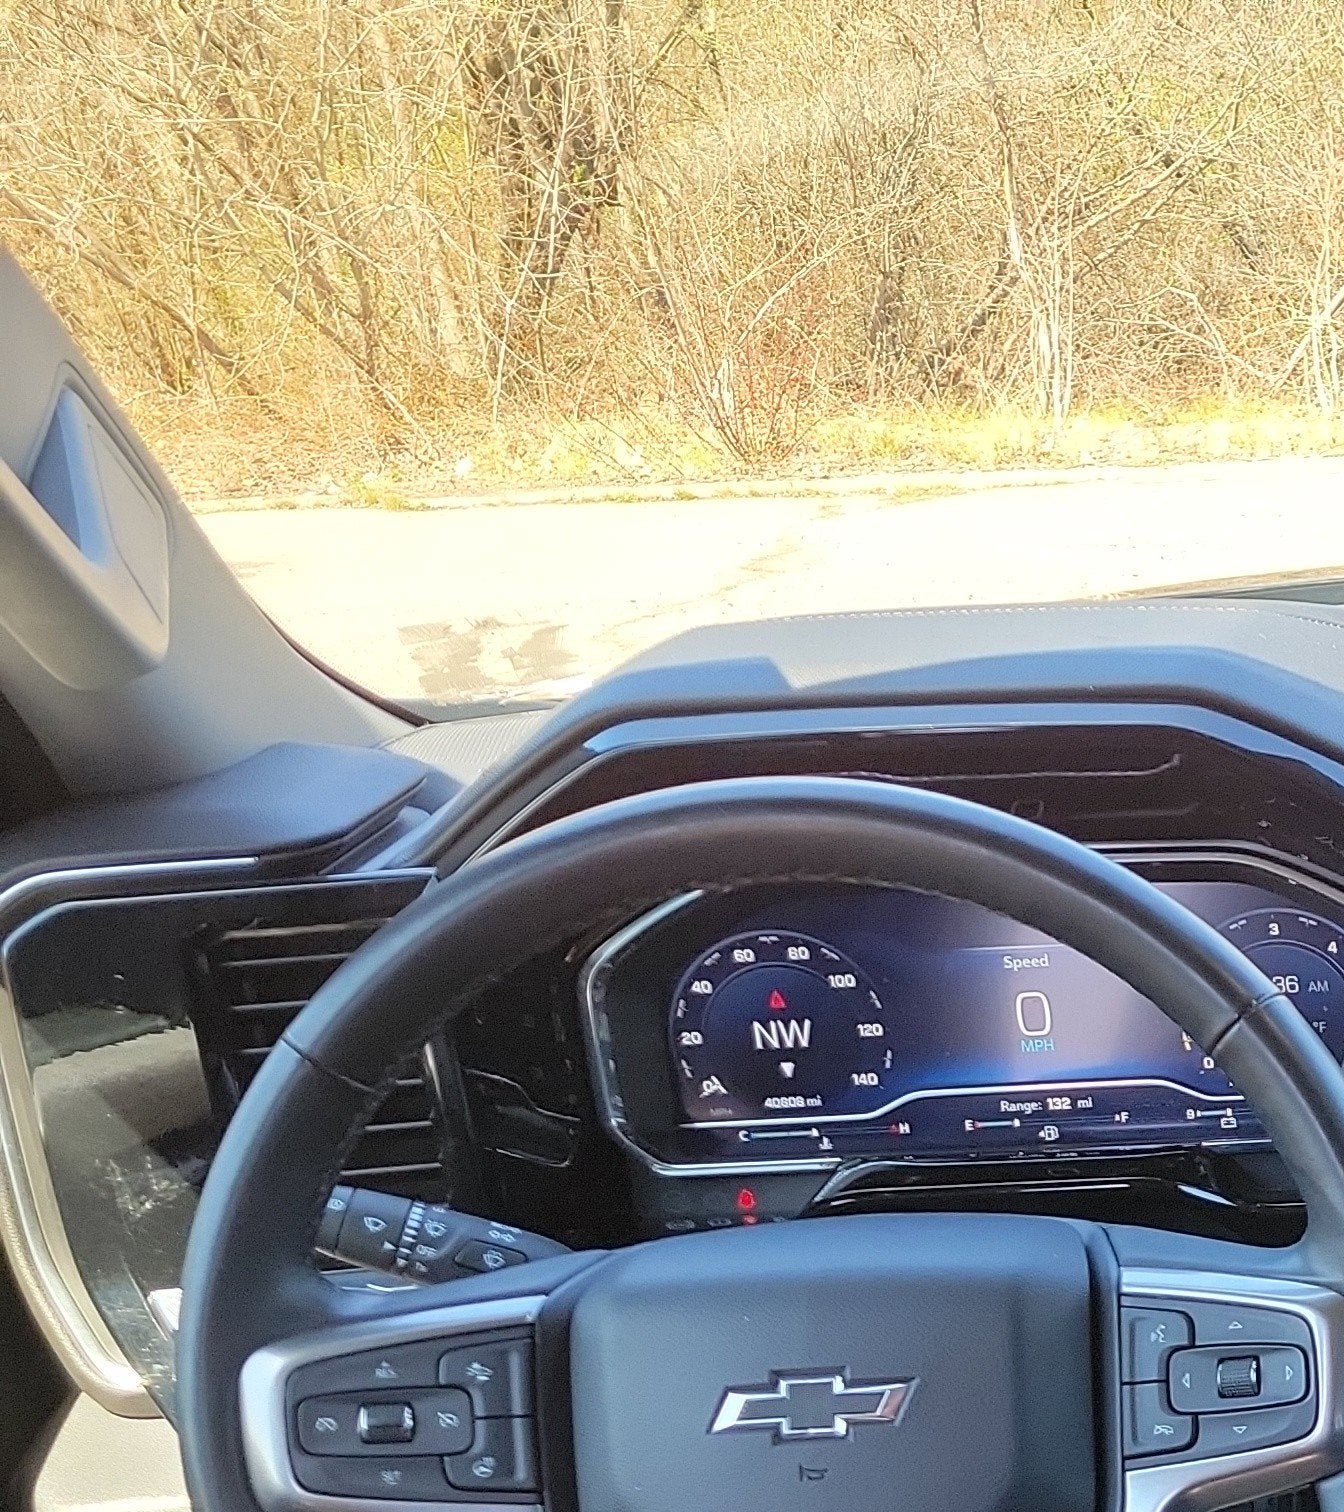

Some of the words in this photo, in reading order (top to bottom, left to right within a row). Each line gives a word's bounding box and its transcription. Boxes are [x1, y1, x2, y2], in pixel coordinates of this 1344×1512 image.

[1267, 922, 1281, 936] 3
[786, 946, 811, 961] 80
[1327, 941, 1339, 954] 4
[733, 948, 756, 963] 60
[1003, 954, 1050, 972] Speed
[690, 980, 714, 995] 40
[828, 973, 857, 989] 100
[1307, 980, 1330, 993] AM
[1015, 991, 1052, 1036] 0
[752, 1018, 812, 1050] NW
[856, 1023, 884, 1038] 120
[680, 1031, 703, 1046] 20
[1020, 1038, 1055, 1053] MPH
[851, 1072, 879, 1087] 140
[806, 1094, 823, 1107] mi
[1000, 1100, 1043, 1115] Range:
[1046, 1097, 1073, 1111] 132
[1077, 1096, 1093, 1109] mi
[964, 1119, 975, 1132] E
[738, 1129, 750, 1142] C
